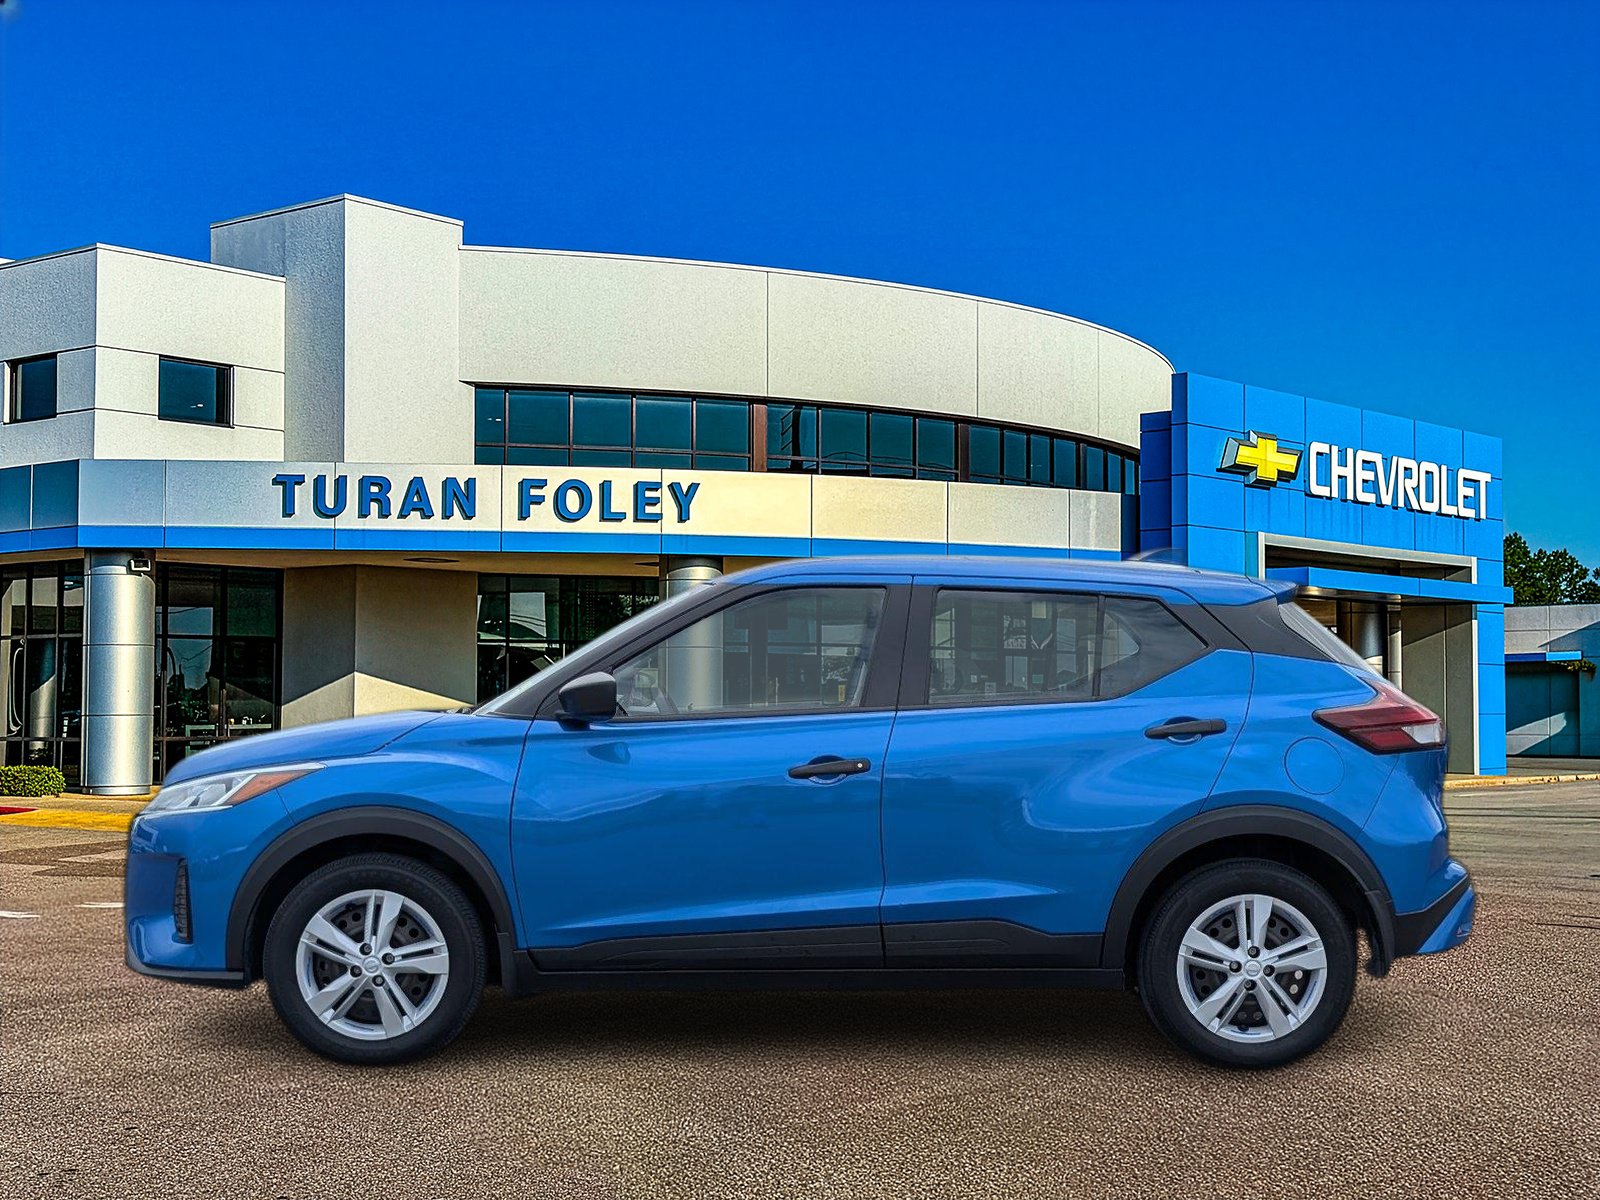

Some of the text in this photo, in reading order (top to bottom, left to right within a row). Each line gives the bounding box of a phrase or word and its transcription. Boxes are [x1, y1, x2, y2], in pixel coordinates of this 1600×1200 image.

[272, 473, 700, 523] TURAN FOLEY
[1308, 441, 1492, 520] CHEVROLET
